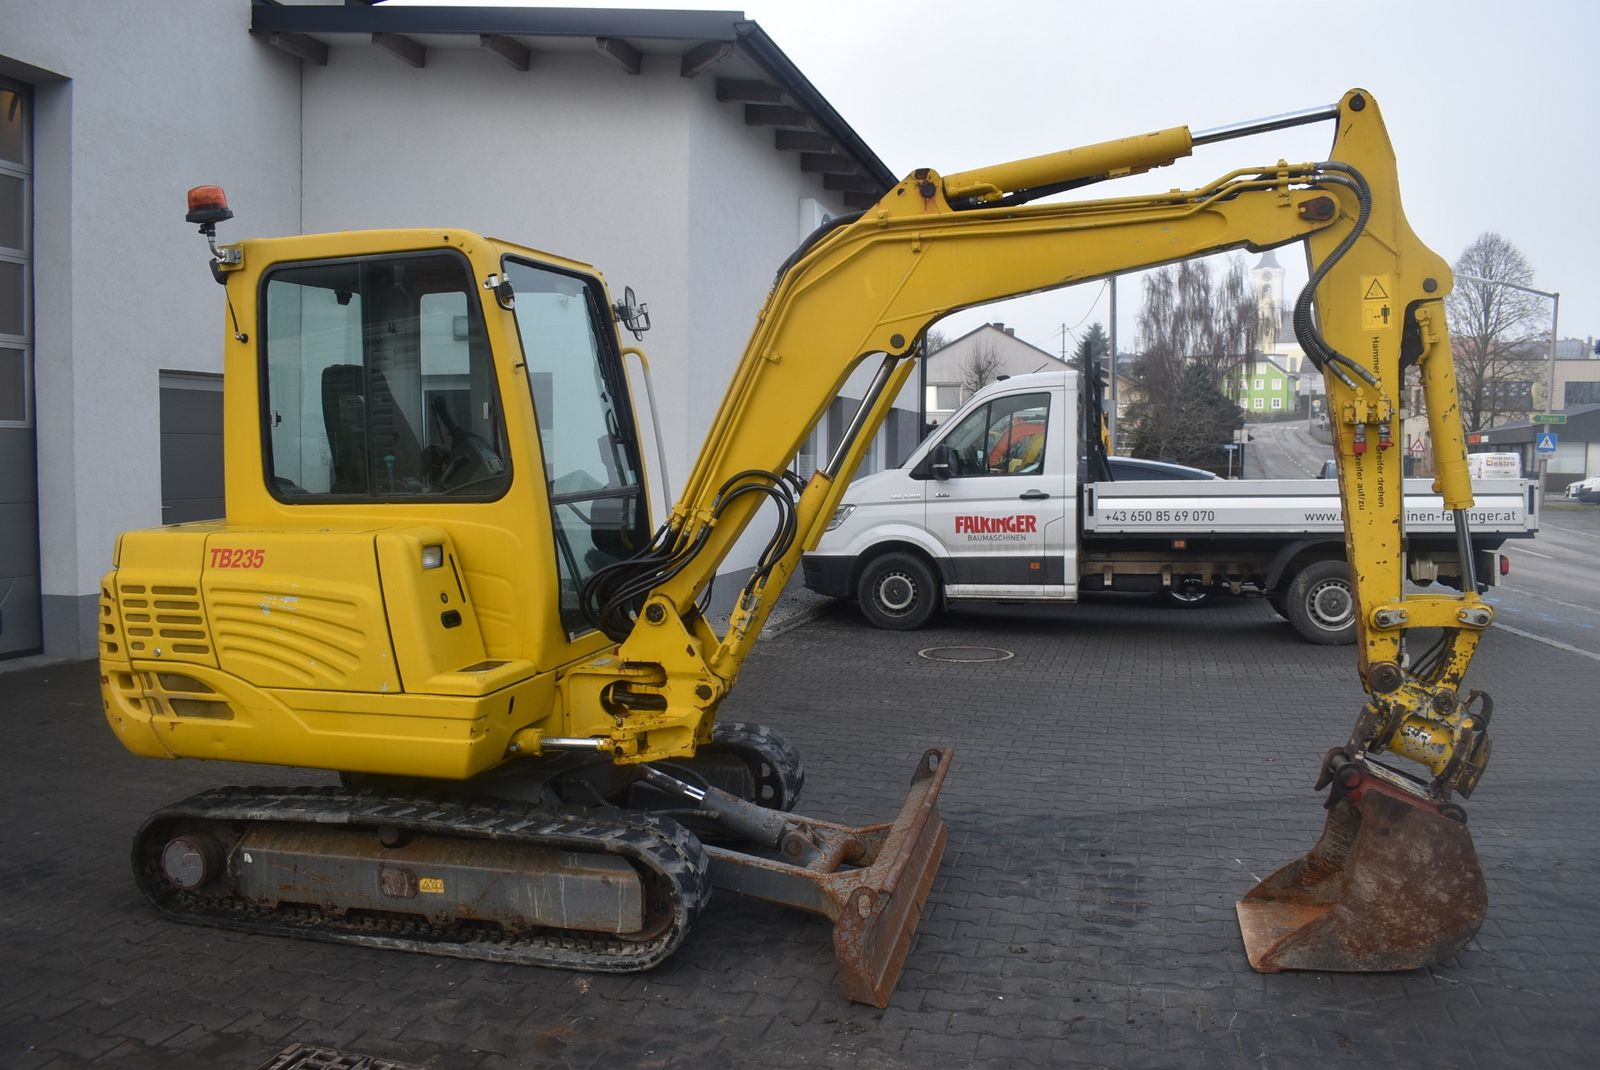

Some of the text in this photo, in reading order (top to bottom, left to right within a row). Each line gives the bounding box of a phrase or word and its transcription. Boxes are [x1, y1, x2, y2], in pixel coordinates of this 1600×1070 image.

[1372, 336, 1380, 375] Hammer
[1486, 458, 1516, 467] Elektro
[1357, 483, 1366, 511] auf/zu
[1377, 477, 1385, 508] drehen
[1105, 510, 1215, 522] +43 650 85 69 070
[967, 534, 1027, 542] BAUMASCHINEN
[210, 548, 266, 569] TB235
